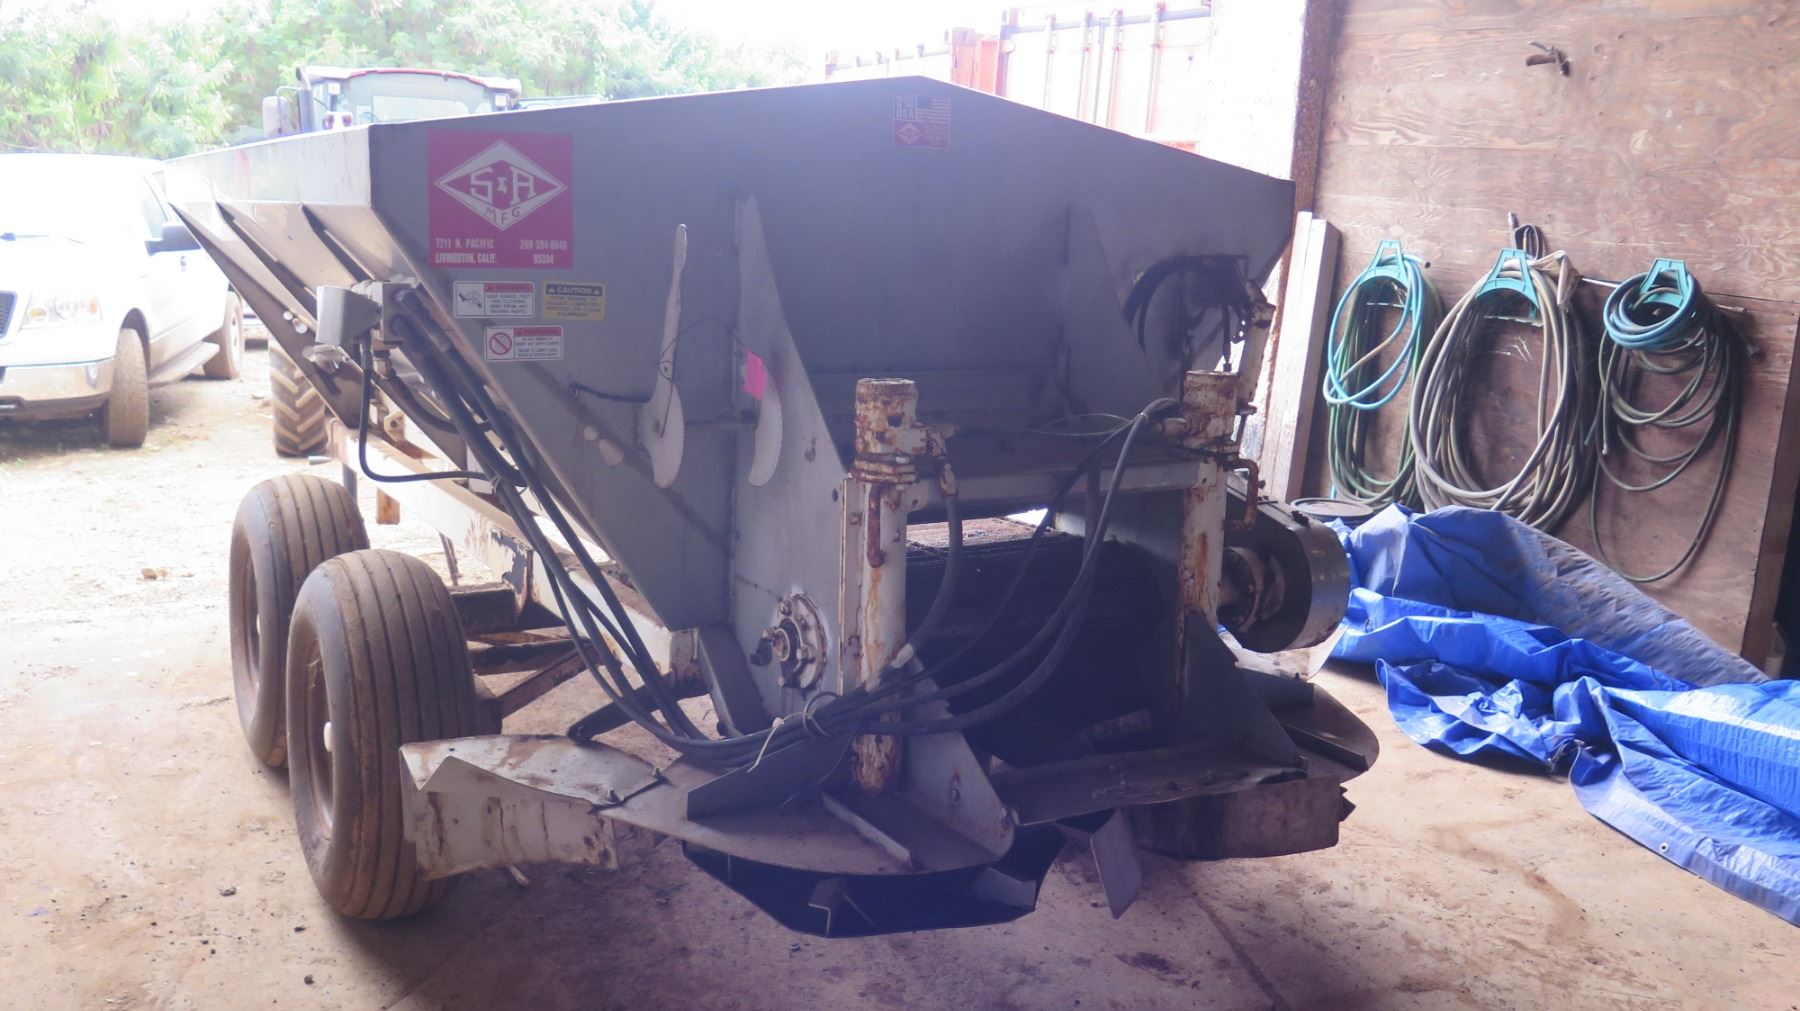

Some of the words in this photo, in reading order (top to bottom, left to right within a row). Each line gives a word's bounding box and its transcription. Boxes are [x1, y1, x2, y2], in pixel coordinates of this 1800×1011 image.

[484, 206, 521, 226] MFG
[465, 238, 495, 249] PACIFIC
[556, 286, 592, 295] CAUTION
